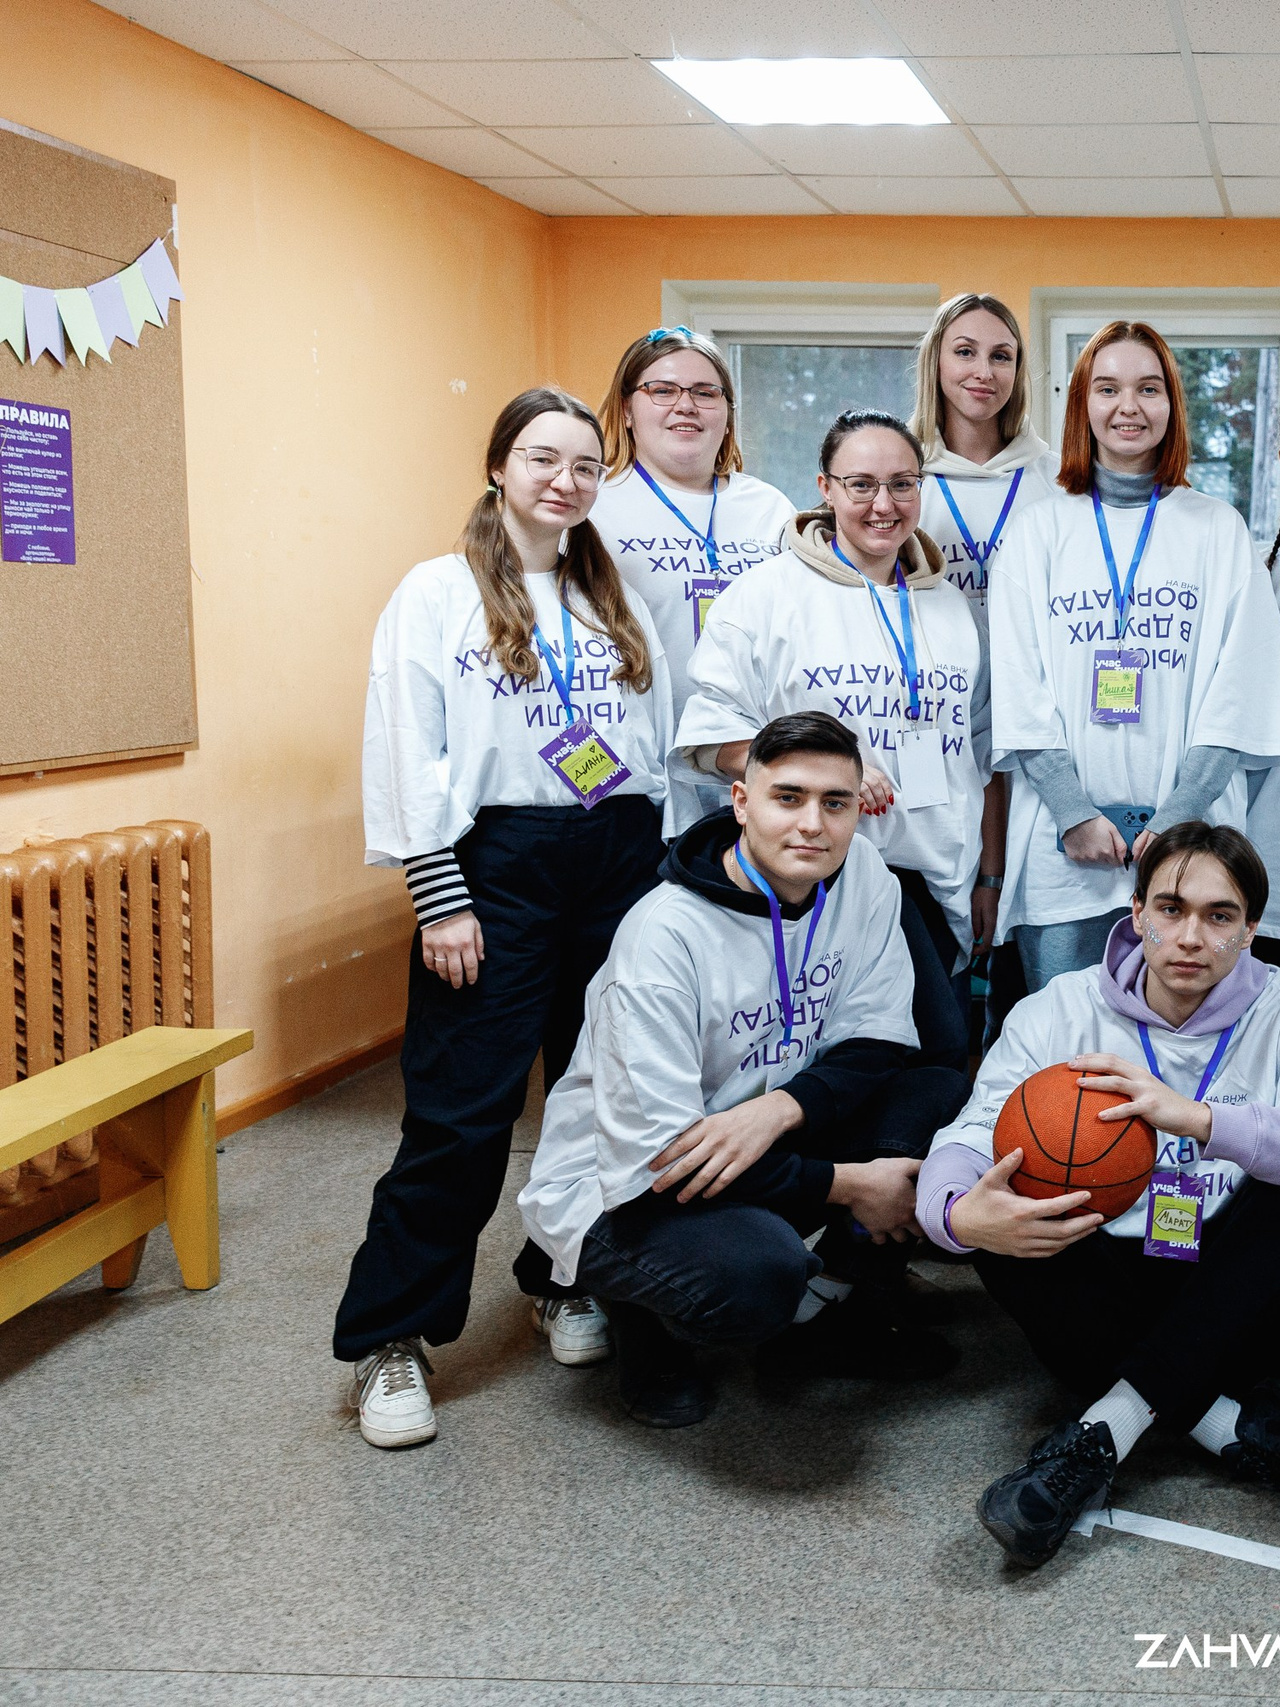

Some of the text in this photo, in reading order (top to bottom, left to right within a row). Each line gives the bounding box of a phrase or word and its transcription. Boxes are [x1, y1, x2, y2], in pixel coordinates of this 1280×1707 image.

[0, 405, 69, 430] ПРАВИЛА
[1095, 659, 1121, 669] учас
[547, 740, 576, 767] учас
[573, 753, 608, 783] ДИАНА
[1205, 1093, 1247, 1104] НА ВНЖ
[1152, 1183, 1181, 1194] учас
